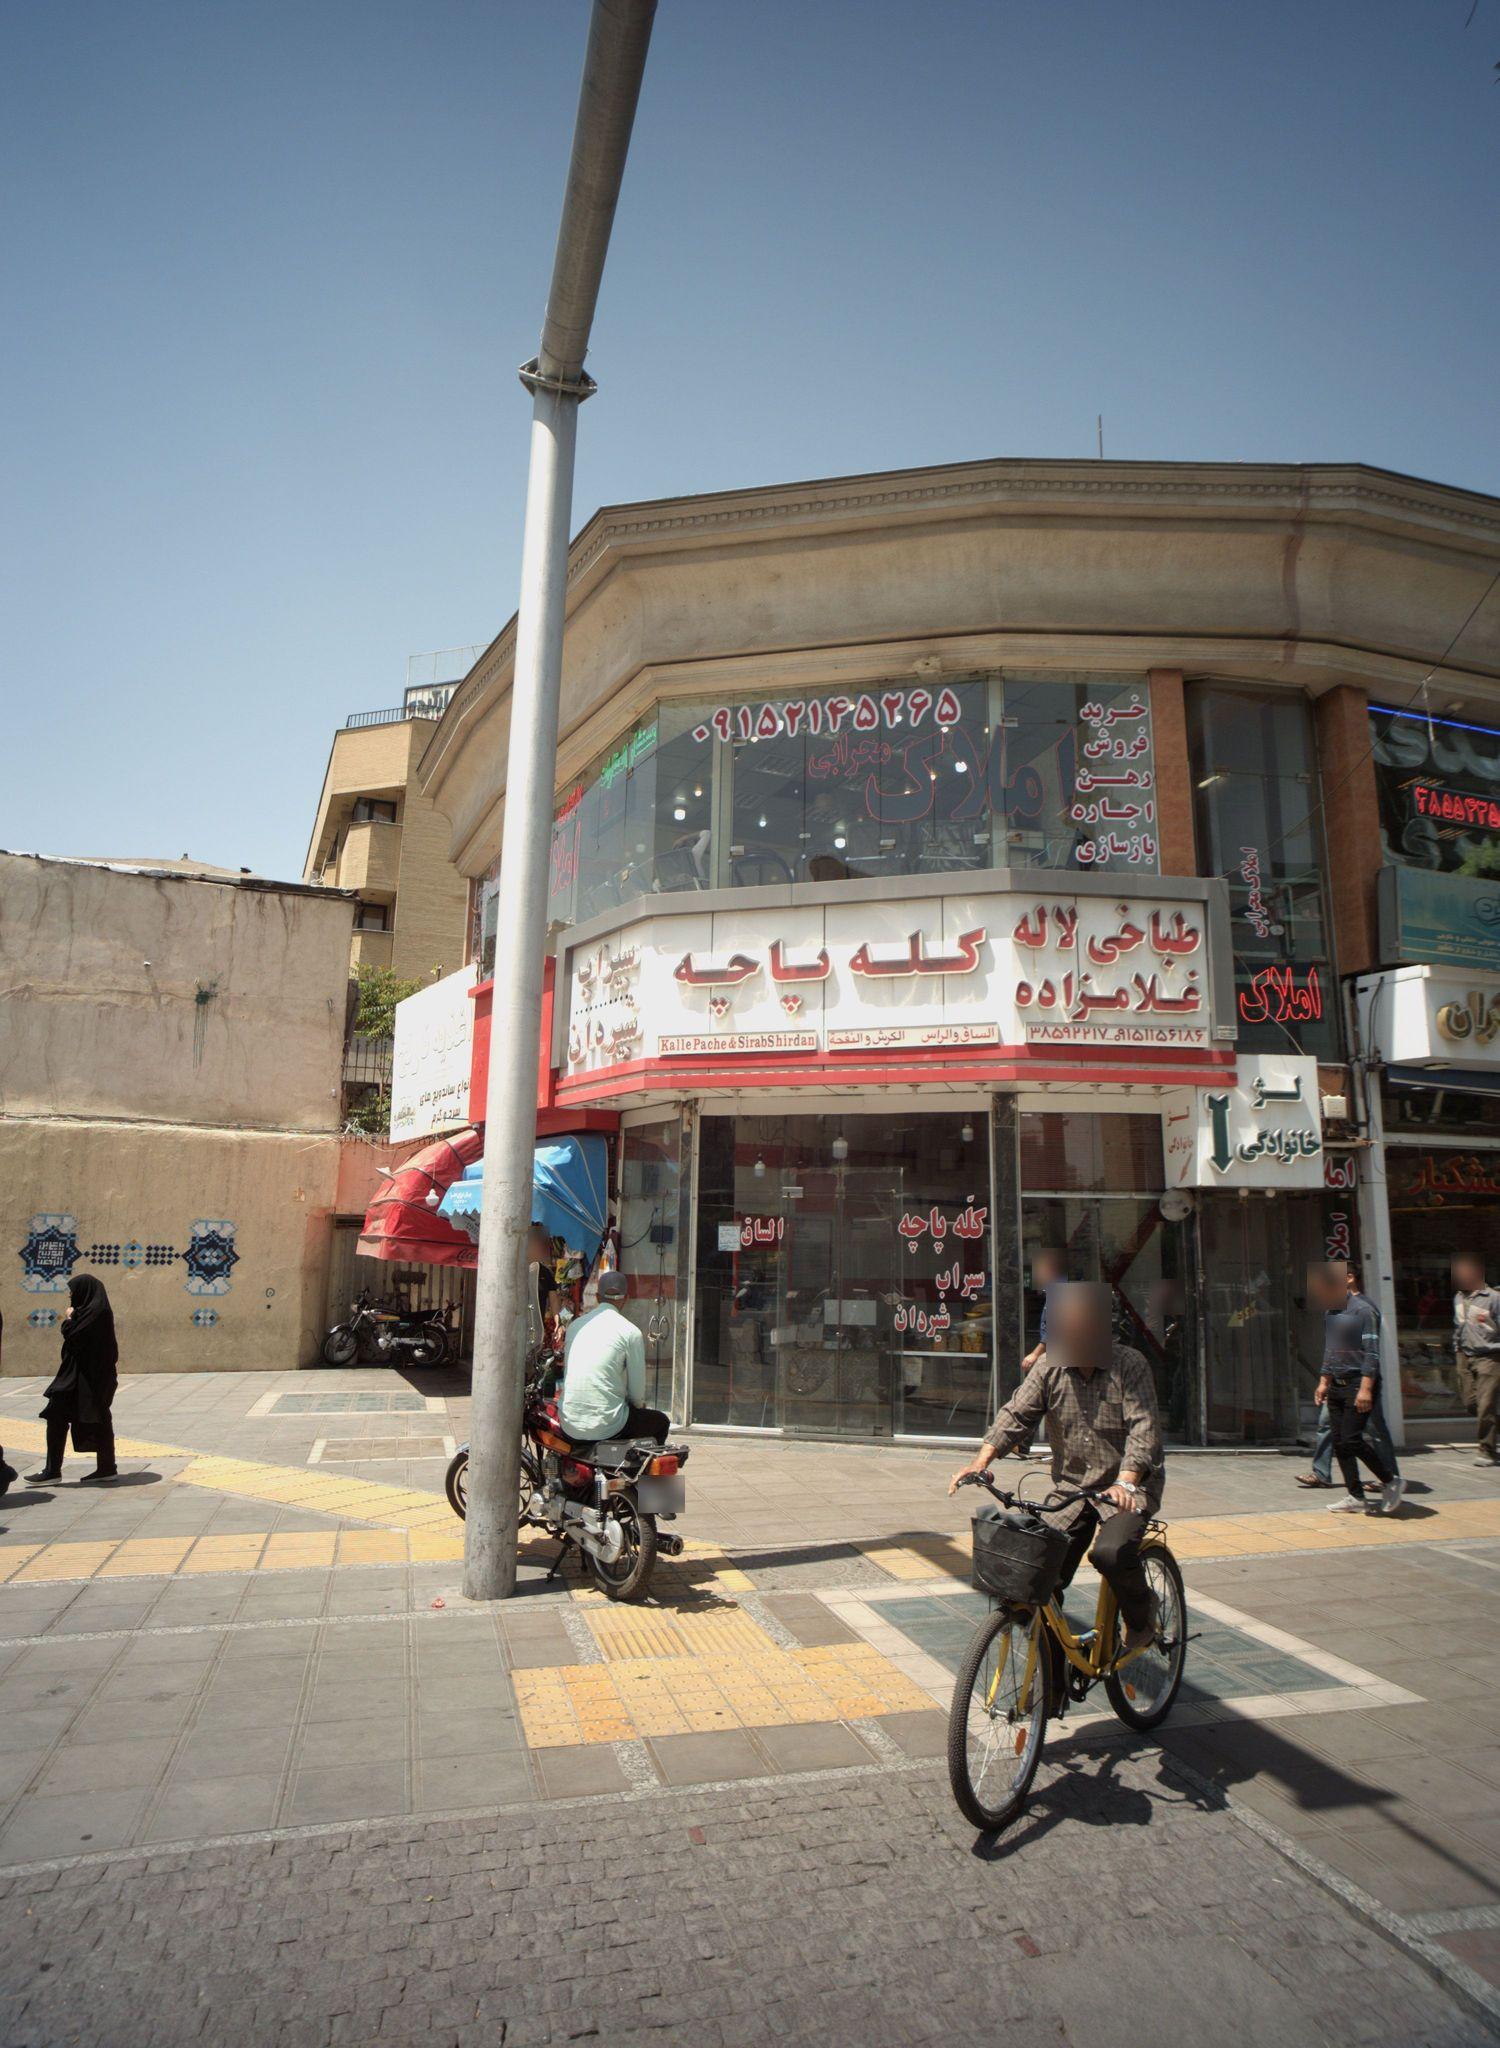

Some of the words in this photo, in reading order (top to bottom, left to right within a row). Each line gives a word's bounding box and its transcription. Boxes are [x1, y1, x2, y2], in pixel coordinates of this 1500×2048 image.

[692, 688, 961, 742] ۰۹۱۵۲۱۴۵۲۶۵
[1080, 694, 1148, 727] خرید
[1084, 726, 1150, 758] فروش
[865, 725, 1077, 823] املاک
[1076, 768, 1153, 792] رهن
[1071, 797, 1154, 828] اجاره
[1076, 832, 1157, 864] بازسازی
[1240, 847, 1261, 890] املاک
[1012, 904, 1080, 950] لاله
[1086, 902, 1202, 970] طباخی
[577, 943, 640, 1000] سیراب
[848, 926, 987, 978] کله
[672, 938, 832, 1018] پاچه
[1014, 969, 1203, 1023] غلامزاده
[1240, 966, 1322, 1023] املاک
[661, 1039, 691, 1051] Kalle
[693, 1037, 727, 1050] Pache
[728, 1037, 737, 1049] &
[962, 1026, 995, 1043] الساق
[1252, 1075, 1304, 1109] لژ
[1237, 1129, 1322, 1164] خانوادگی
[1407, 1155, 1500, 1206] شکبار
[740, 1217, 784, 1246] الساق
[898, 1206, 948, 1255] پاچه
[935, 1261, 986, 1300] سیراب
[894, 1302, 951, 1343] شیردان
